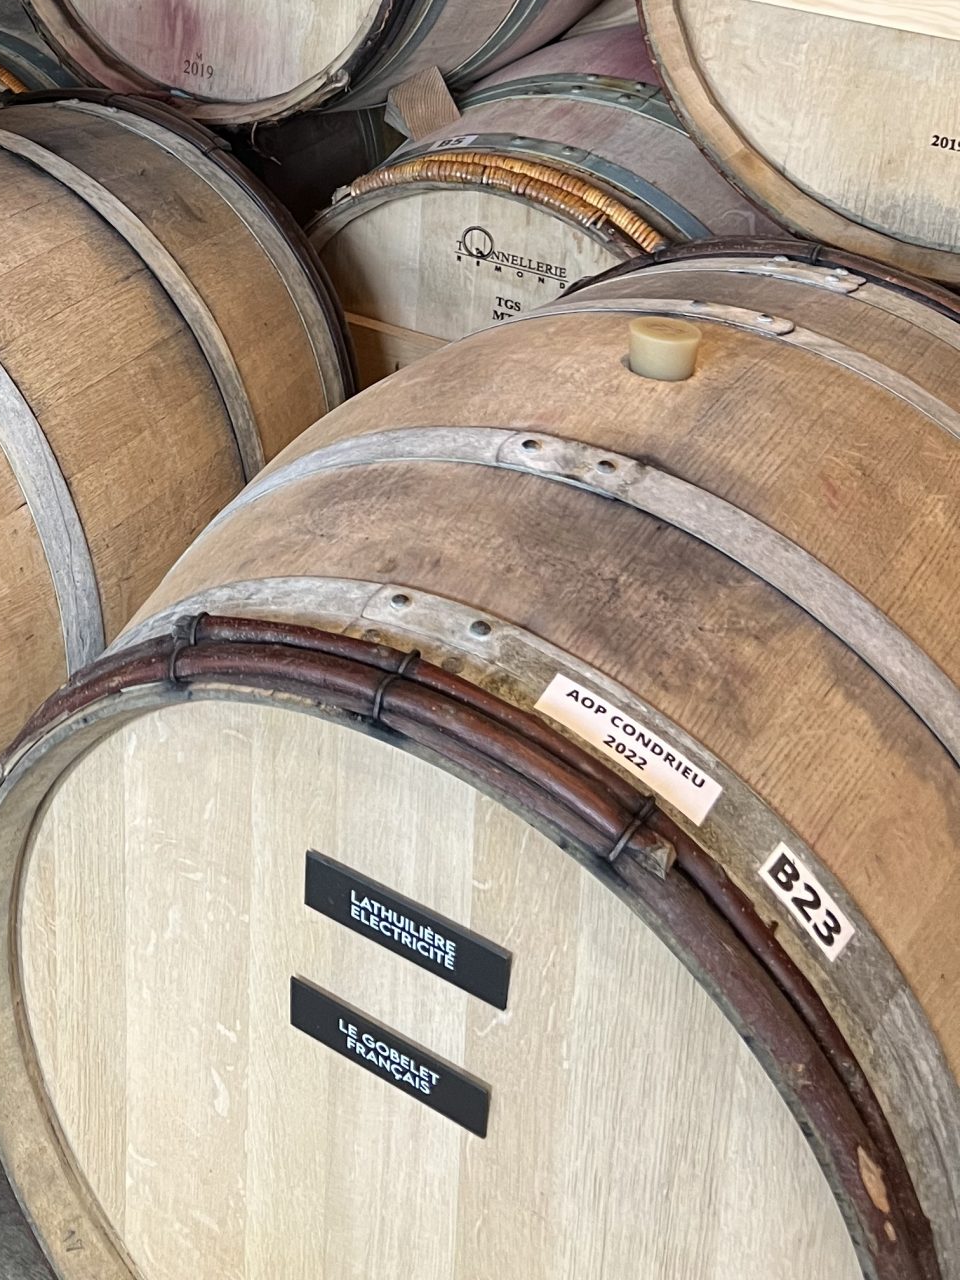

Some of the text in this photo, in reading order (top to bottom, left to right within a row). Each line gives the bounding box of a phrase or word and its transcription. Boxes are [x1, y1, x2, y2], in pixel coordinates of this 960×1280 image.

[183, 59, 214, 80] 2019
[456, 254, 566, 290] REMOND
[495, 296, 521, 312] TGS
[566, 689, 706, 789] AOP CONDRIEU
[603, 734, 648, 771] 2022
[350, 889, 456, 954] LATHUILIÈRE
[768, 852, 842, 947] B23
[338, 1018, 440, 1086] LE GOBELET
[346, 1038, 430, 1095] FRANÇAIS
